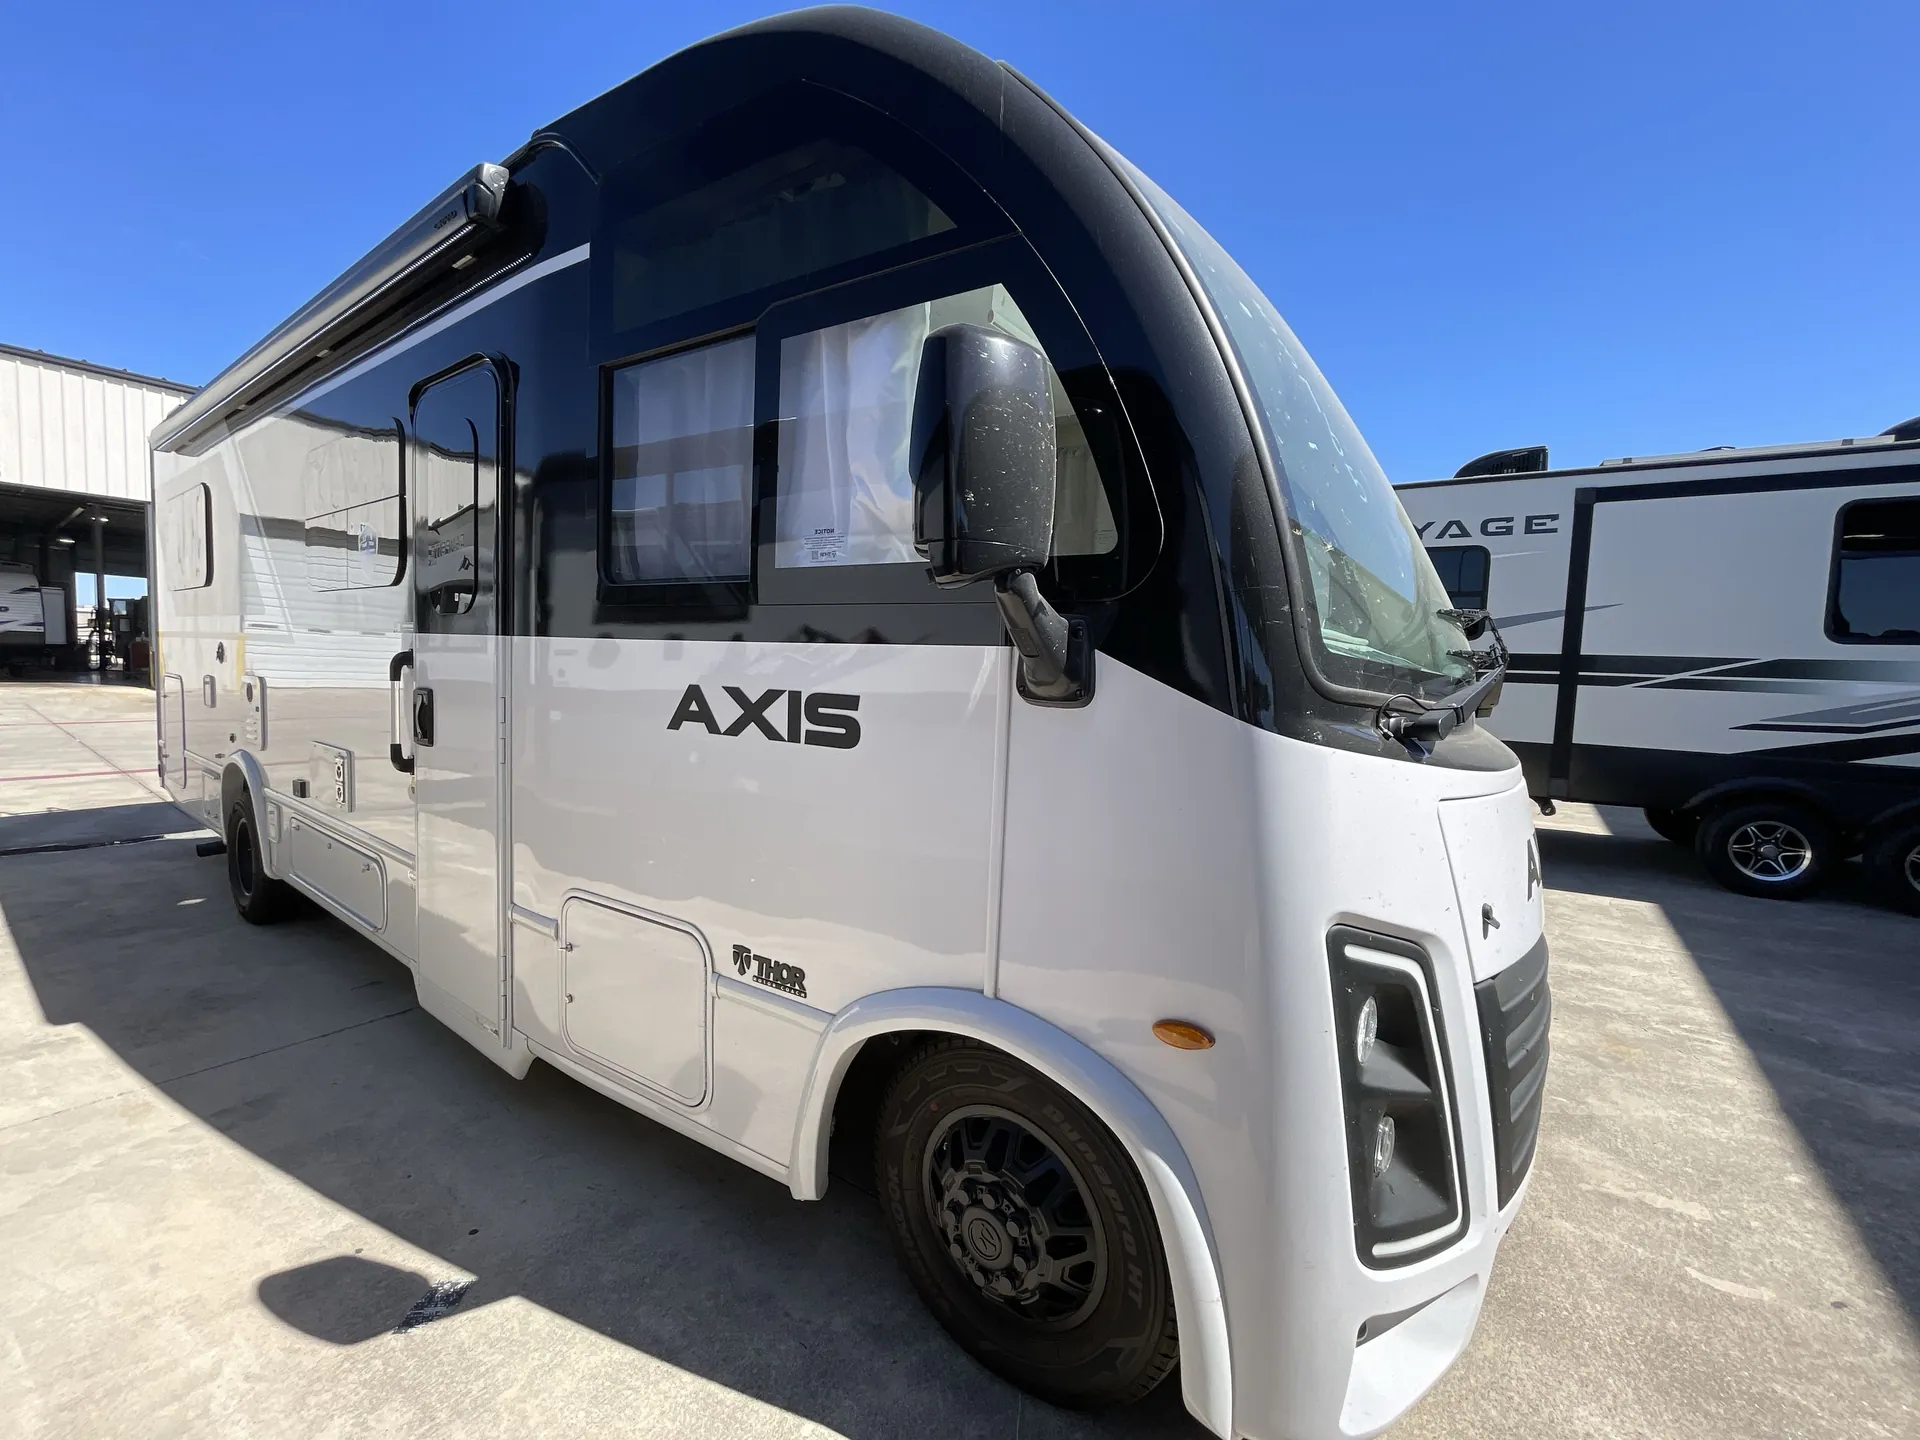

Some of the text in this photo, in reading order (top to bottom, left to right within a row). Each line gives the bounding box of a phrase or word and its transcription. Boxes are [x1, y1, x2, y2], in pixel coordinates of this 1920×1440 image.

[666, 684, 861, 750] AXIS
[1527, 830, 1541, 902] A
[753, 954, 807, 992] THOR
